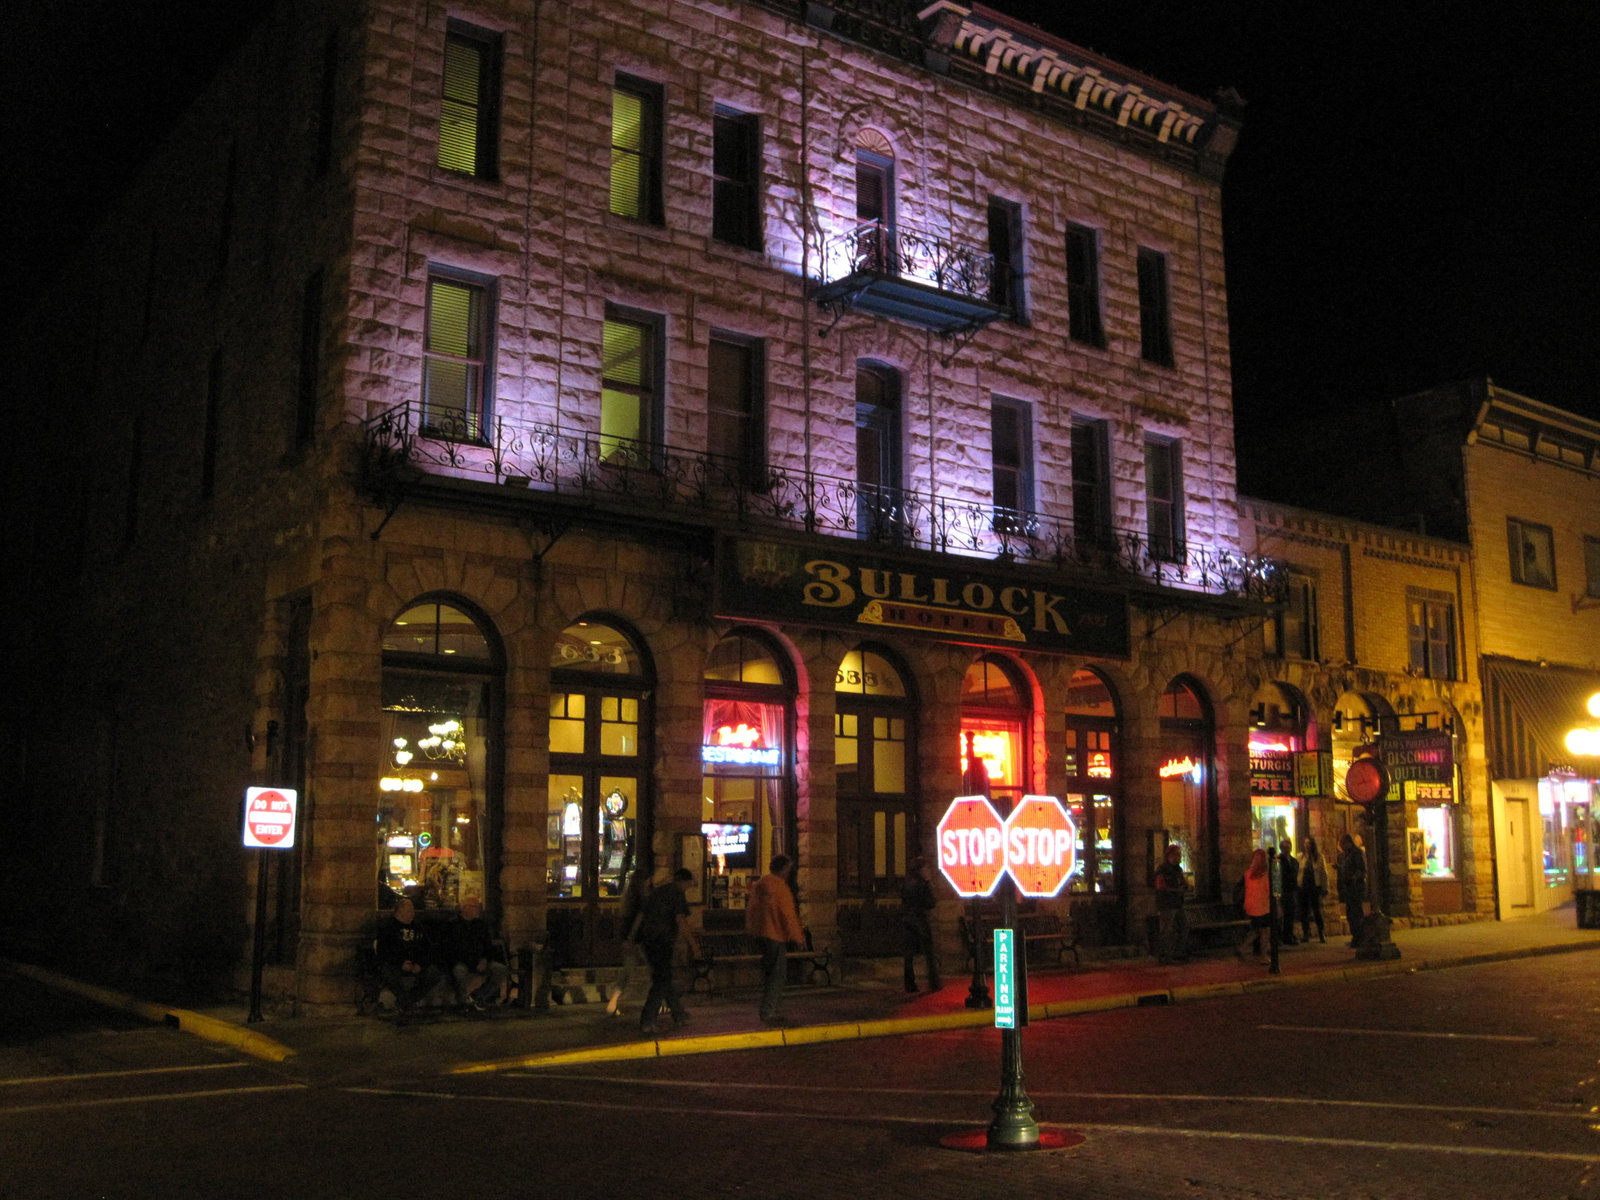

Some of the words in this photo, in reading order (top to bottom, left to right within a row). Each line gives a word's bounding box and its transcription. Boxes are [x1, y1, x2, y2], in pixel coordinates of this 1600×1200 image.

[801, 560, 1072, 635] BULLOCK
[889, 607, 997, 633] HOTEL
[1249, 759, 1292, 771] STURGIS
[1387, 749, 1446, 766] DISCOUNT
[1395, 765, 1440, 780] OUTLET
[1250, 778, 1293, 793] FREE
[254, 799, 268, 810] DO
[271, 800, 288, 811] NOT
[255, 824, 283, 835] ENTER
[943, 827, 1001, 866] STOP
[1009, 826, 1072, 866] STOP
[999, 932, 1009, 1005] PARKING
